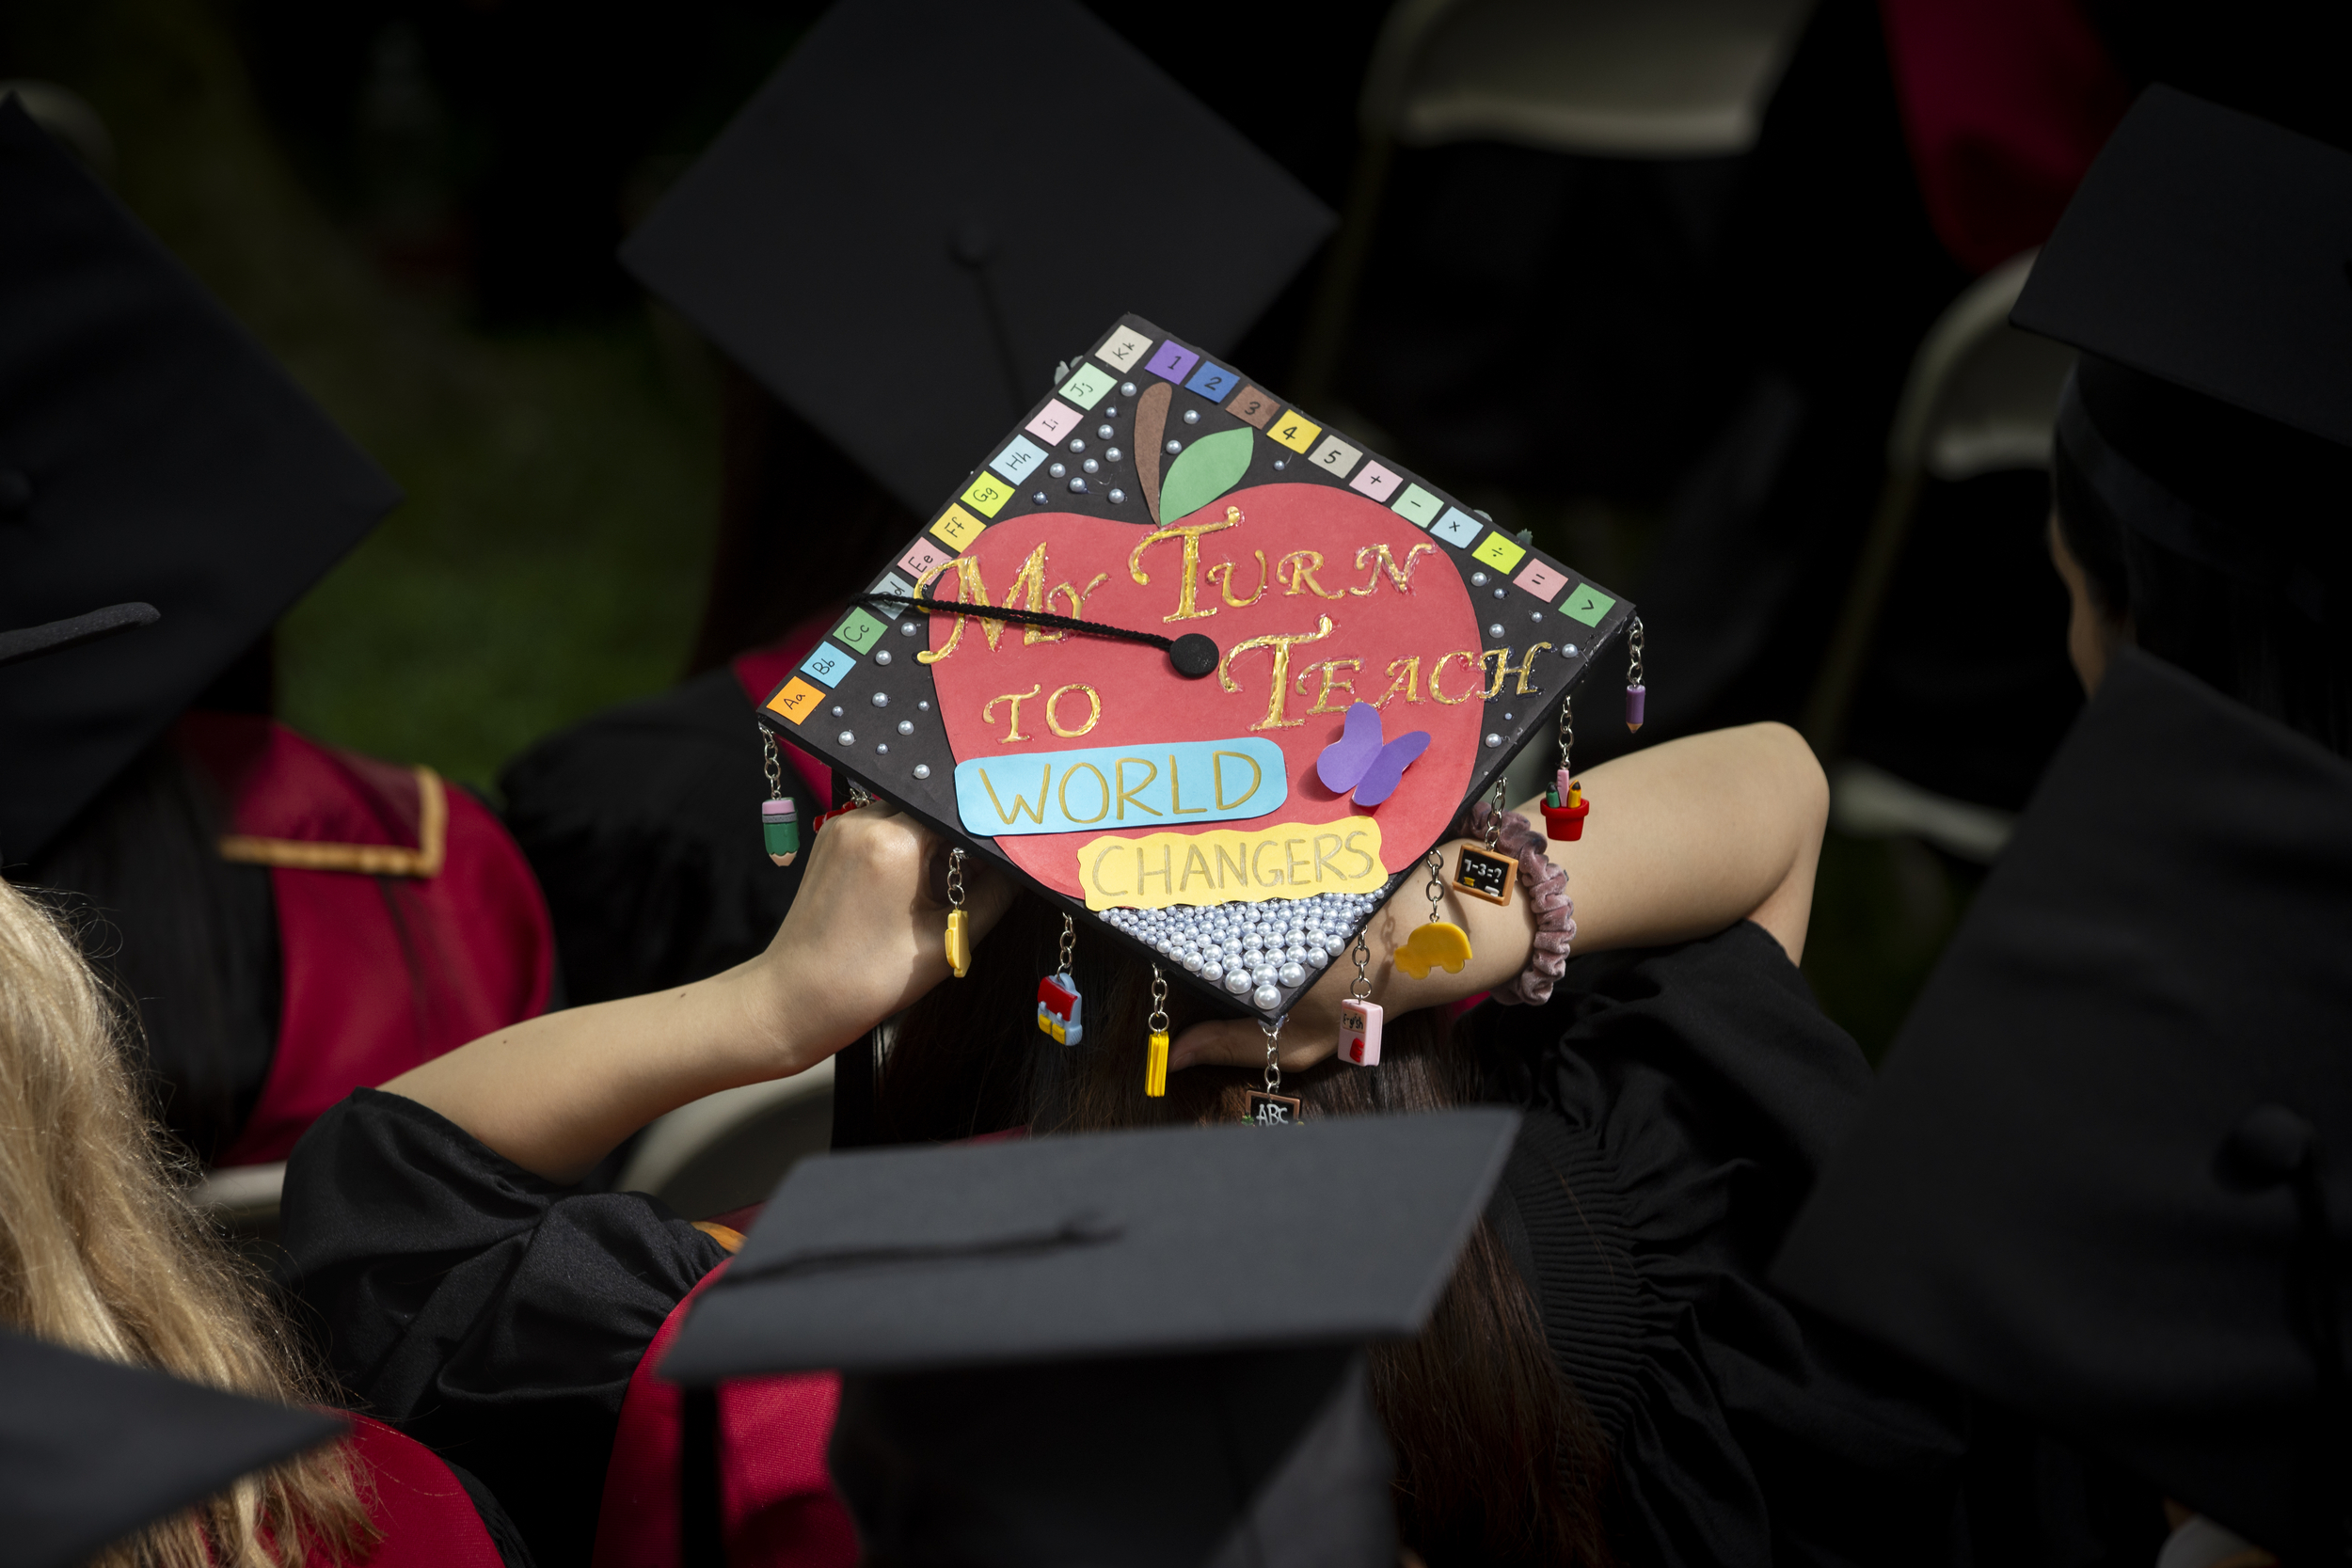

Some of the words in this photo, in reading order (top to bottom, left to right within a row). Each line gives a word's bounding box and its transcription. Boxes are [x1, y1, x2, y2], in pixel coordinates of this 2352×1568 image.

[1168, 356, 1182, 371] 1
[1204, 377, 1221, 390] 2
[1245, 402, 1260, 415] 3
[1282, 426, 1297, 441] 4
[1324, 451, 1341, 464] 5
[784, 693, 805, 710] Aa
[812, 658, 834, 674] Bb
[843, 624, 869, 642] Cc
[908, 555, 933, 574] Ee
[945, 516, 965, 538] Ff
[973, 486, 998, 502] Gg
[1006, 451, 1031, 470] Hh
[1070, 383, 1093, 397] Jj
[1112, 341, 1135, 360] Kk
[983, 683, 1102, 743] TO
[977, 750, 1263, 826] WORLD
[1092, 830, 1374, 897] CHANGERS
[1256, 1103, 1289, 1127] ABC
